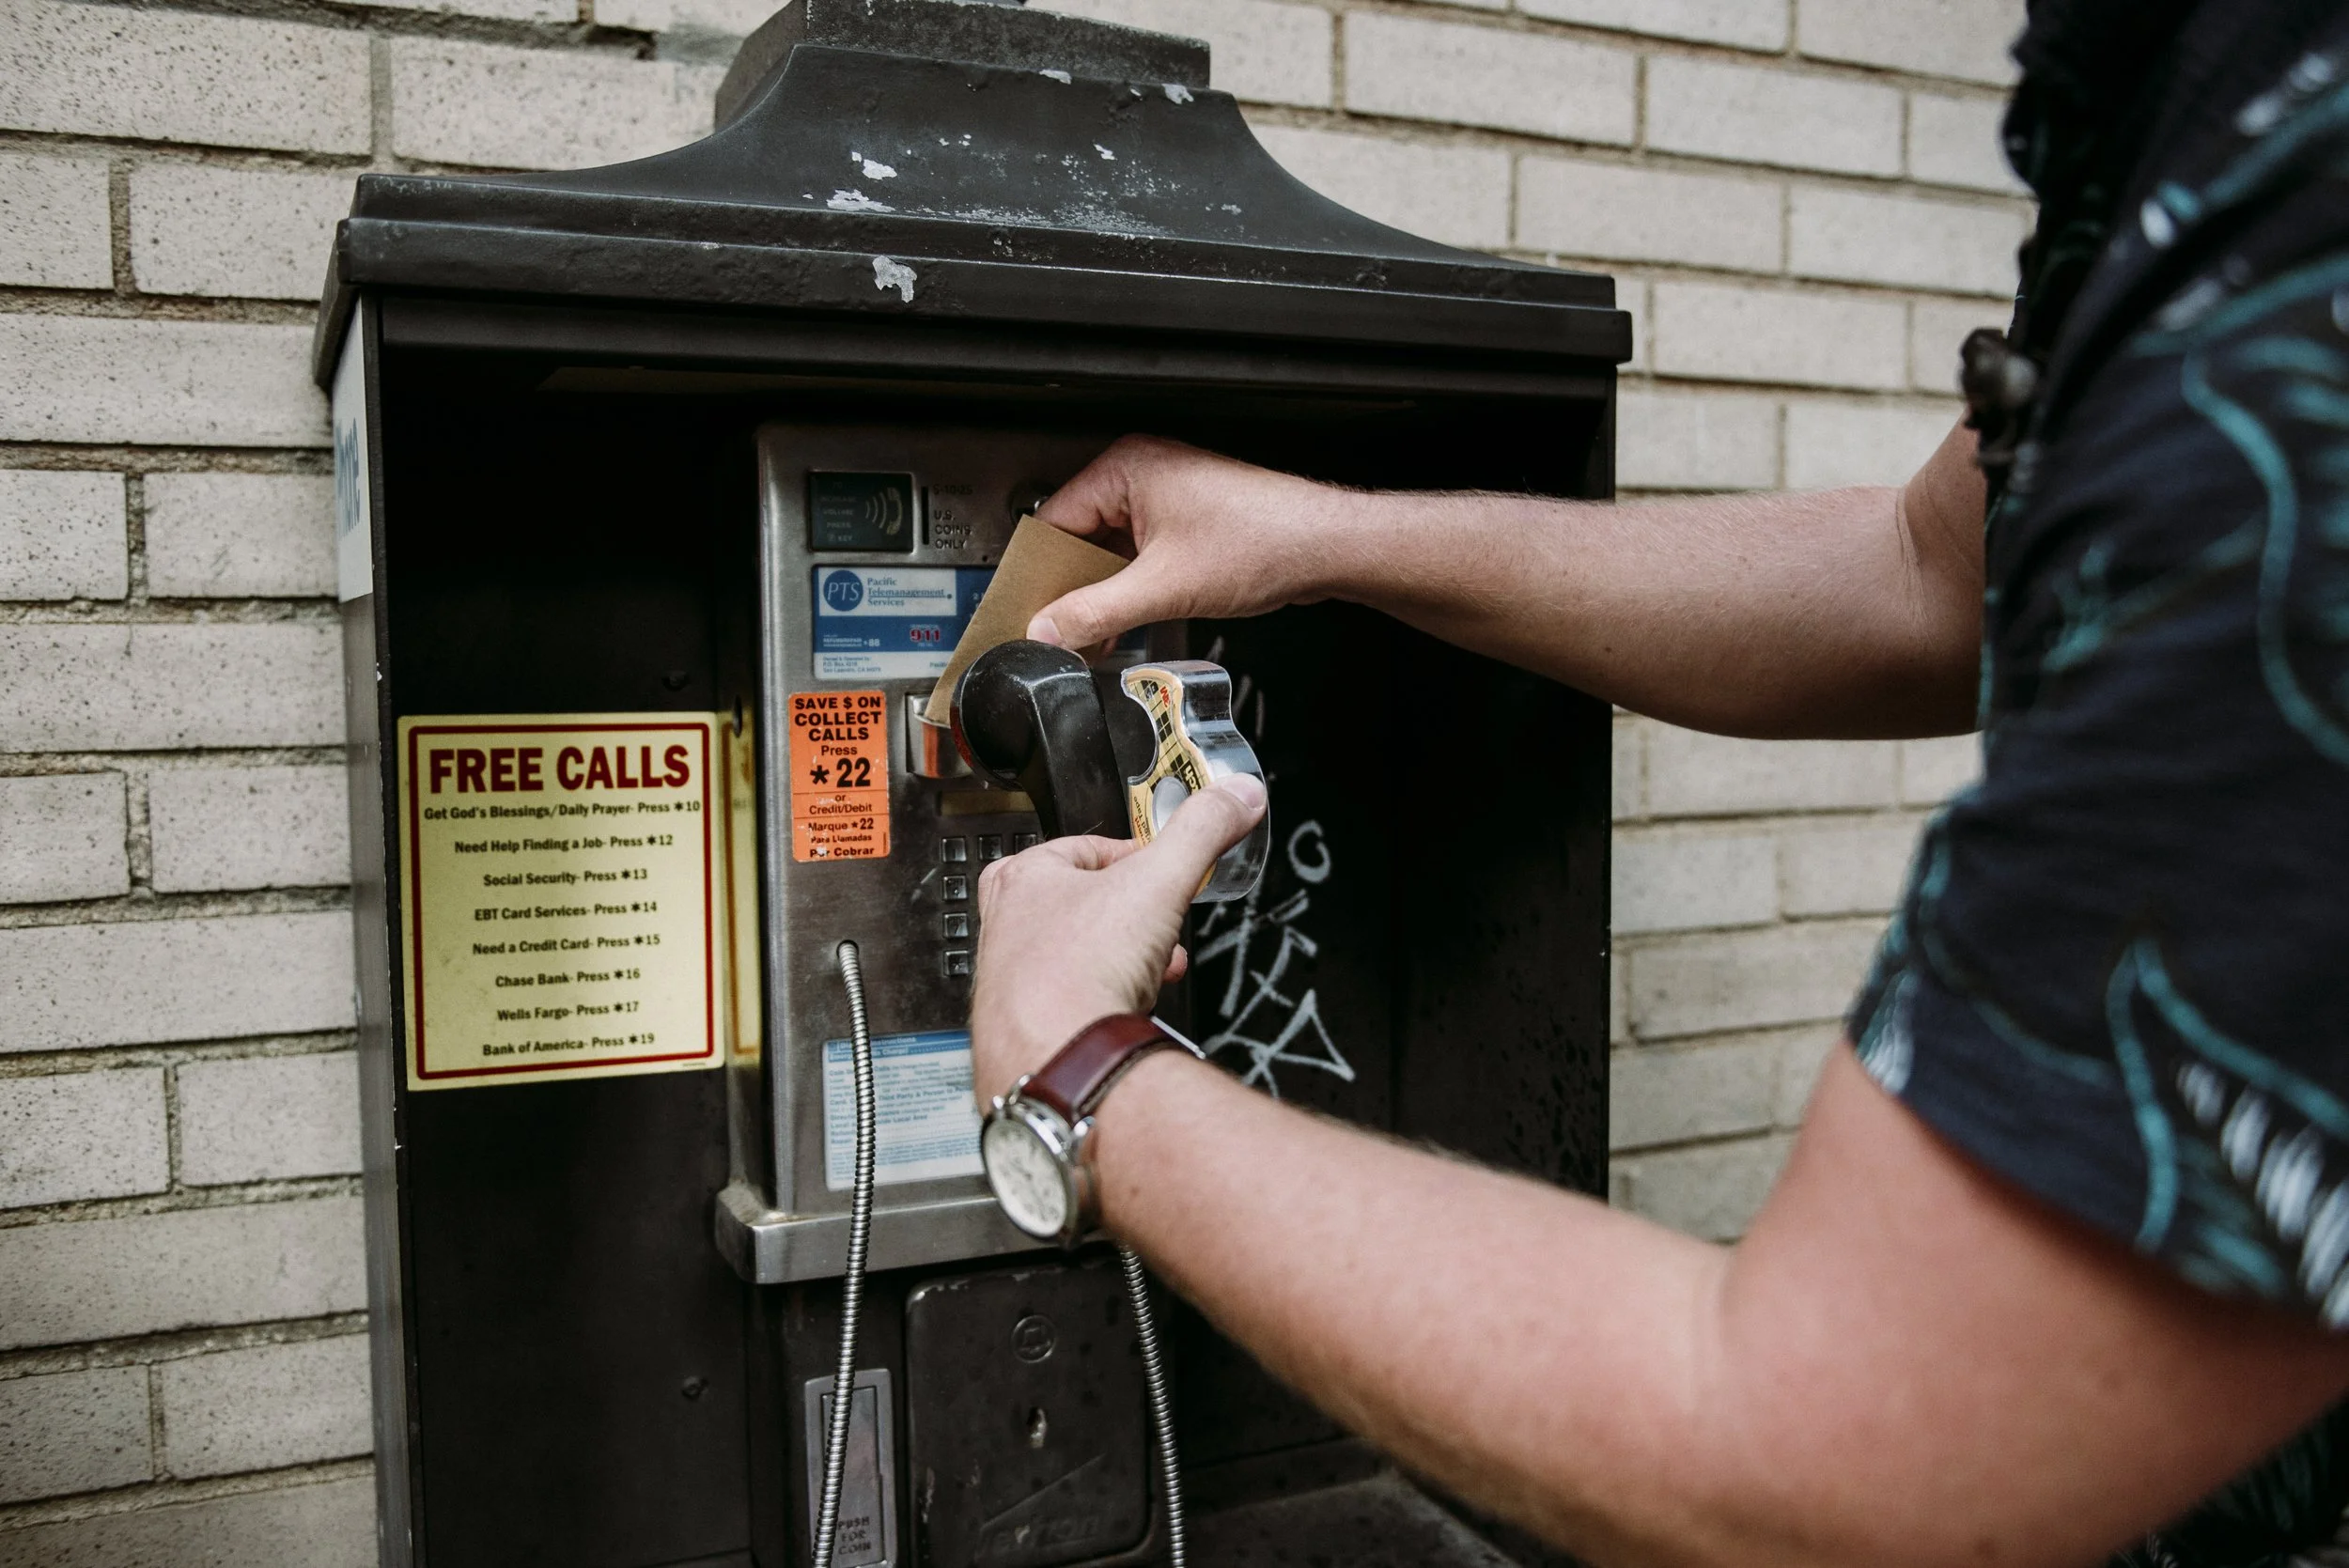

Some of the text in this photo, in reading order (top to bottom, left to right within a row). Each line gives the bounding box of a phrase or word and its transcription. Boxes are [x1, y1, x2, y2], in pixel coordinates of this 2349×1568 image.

[935, 524, 971, 535] COINS
[935, 538, 965, 549] ONLY
[867, 578, 897, 586] Pacific
[828, 582, 860, 600] PTS
[868, 587, 944, 598] Telemanagement
[910, 628, 940, 642] 911
[795, 696, 880, 709] SAVE $ ON
[795, 711, 881, 726] COLLECT
[809, 727, 868, 741] CALLS
[821, 746, 857, 755] Press
[429, 748, 543, 794] FREE
[556, 745, 690, 791] CALLS
[424, 807, 447, 820] Get
[450, 807, 487, 819] God's
[490, 804, 588, 819] Blessings/Daily
[638, 802, 670, 813] Press
[809, 804, 872, 815] Credit/Debit
[808, 822, 848, 831] Marque
[455, 841, 488, 853] Need
[490, 840, 520, 853] Help
[522, 839, 568, 852] Finding
[572, 840, 579, 849] a
[610, 836, 643, 847] Press
[832, 834, 872, 843] Llamadas
[834, 847, 874, 856] Cobrar
[483, 874, 522, 887] Social
[583, 871, 616, 881] Press
[474, 908, 498, 921] EBT
[502, 908, 531, 920] Card
[594, 904, 627, 914] Press
[473, 942, 506, 955] Need
[508, 944, 516, 953] a
[519, 939, 557, 953] Credit
[597, 937, 630, 947] Press
[495, 976, 534, 987] Chase
[577, 971, 610, 983] Press
[497, 1009, 531, 1021] Wells
[576, 1004, 609, 1016] Press
[483, 1044, 515, 1056] Bank
[518, 1041, 531, 1053] of
[592, 1037, 624, 1048] Press
[838, 1516, 869, 1529] PUSH
[842, 1529, 866, 1542] FOR
[838, 1542, 871, 1555] COIN
